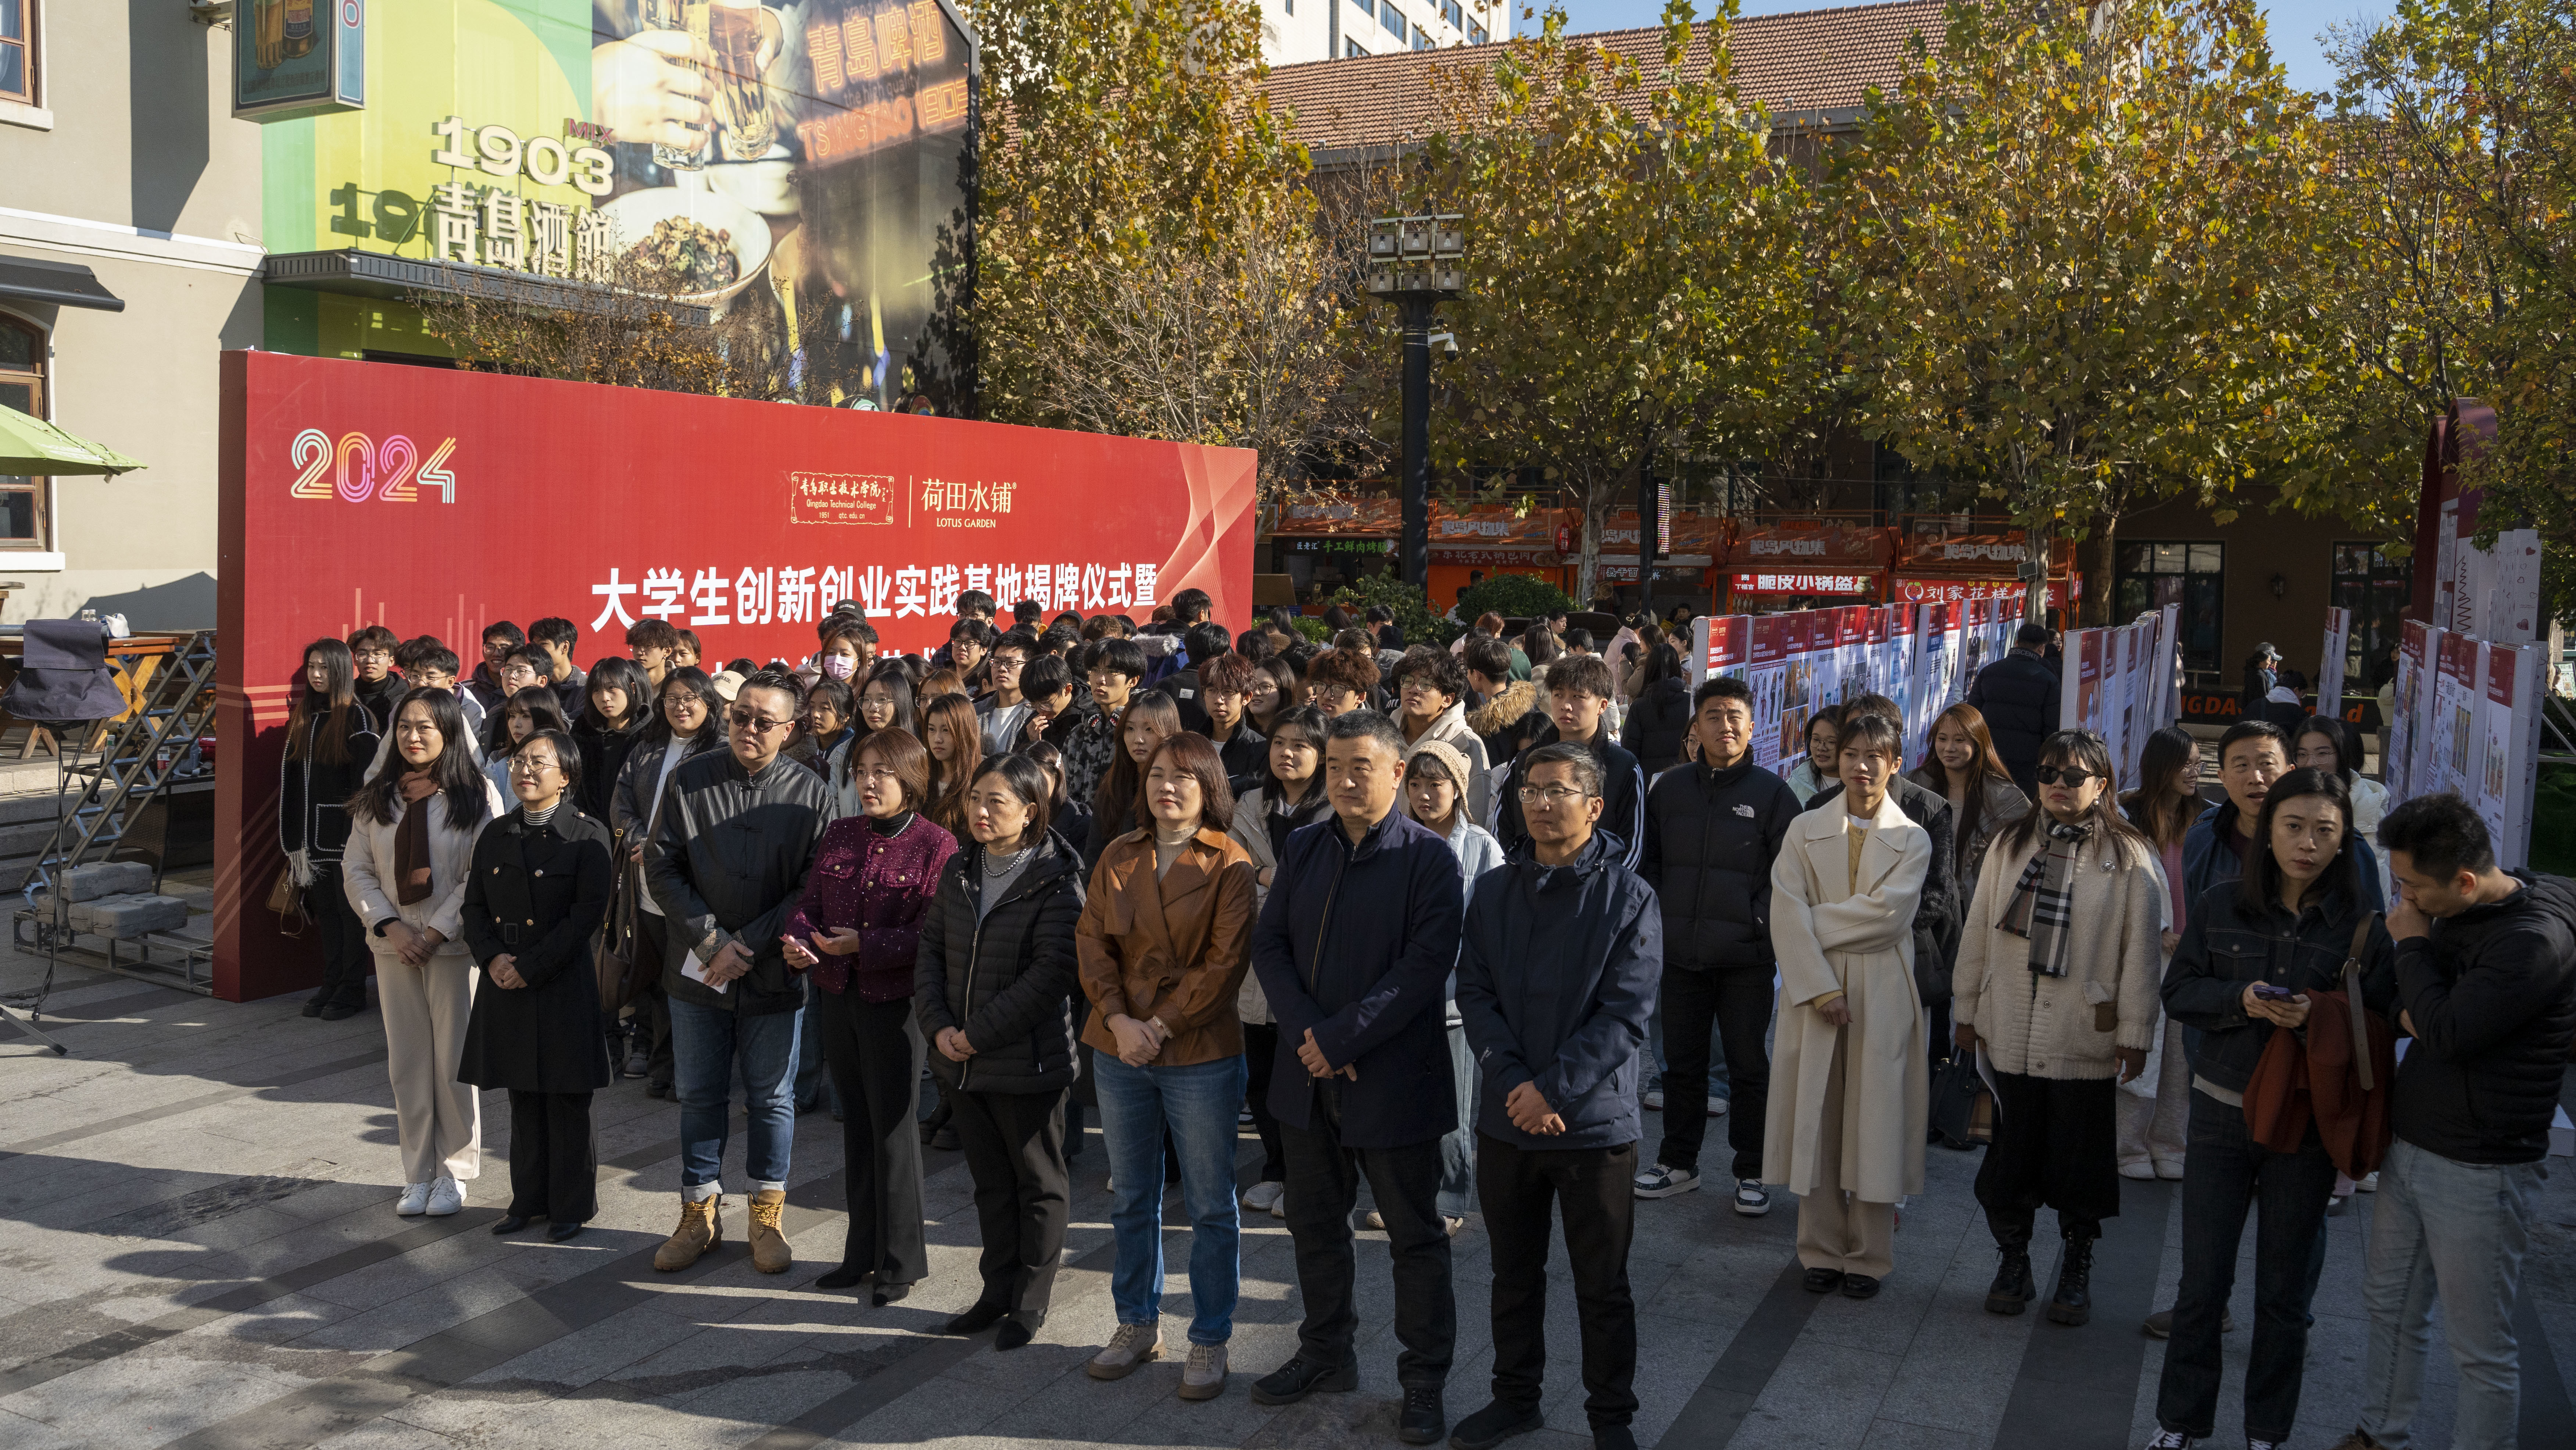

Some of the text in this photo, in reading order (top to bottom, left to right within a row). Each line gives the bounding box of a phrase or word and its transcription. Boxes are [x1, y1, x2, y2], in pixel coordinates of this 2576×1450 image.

[565, 118, 614, 146] MIX
[432, 116, 614, 196] 1903
[290, 428, 456, 504] 2024
[806, 499, 876, 510] Qingdao Technical College
[921, 478, 1012, 513] 荷田水铺
[937, 518, 996, 528] LOTUS GARDEN
[1606, 567, 1639, 578] 热干面
[591, 562, 1157, 633] 大学生创新创业实践基地揭牌仪式暨
